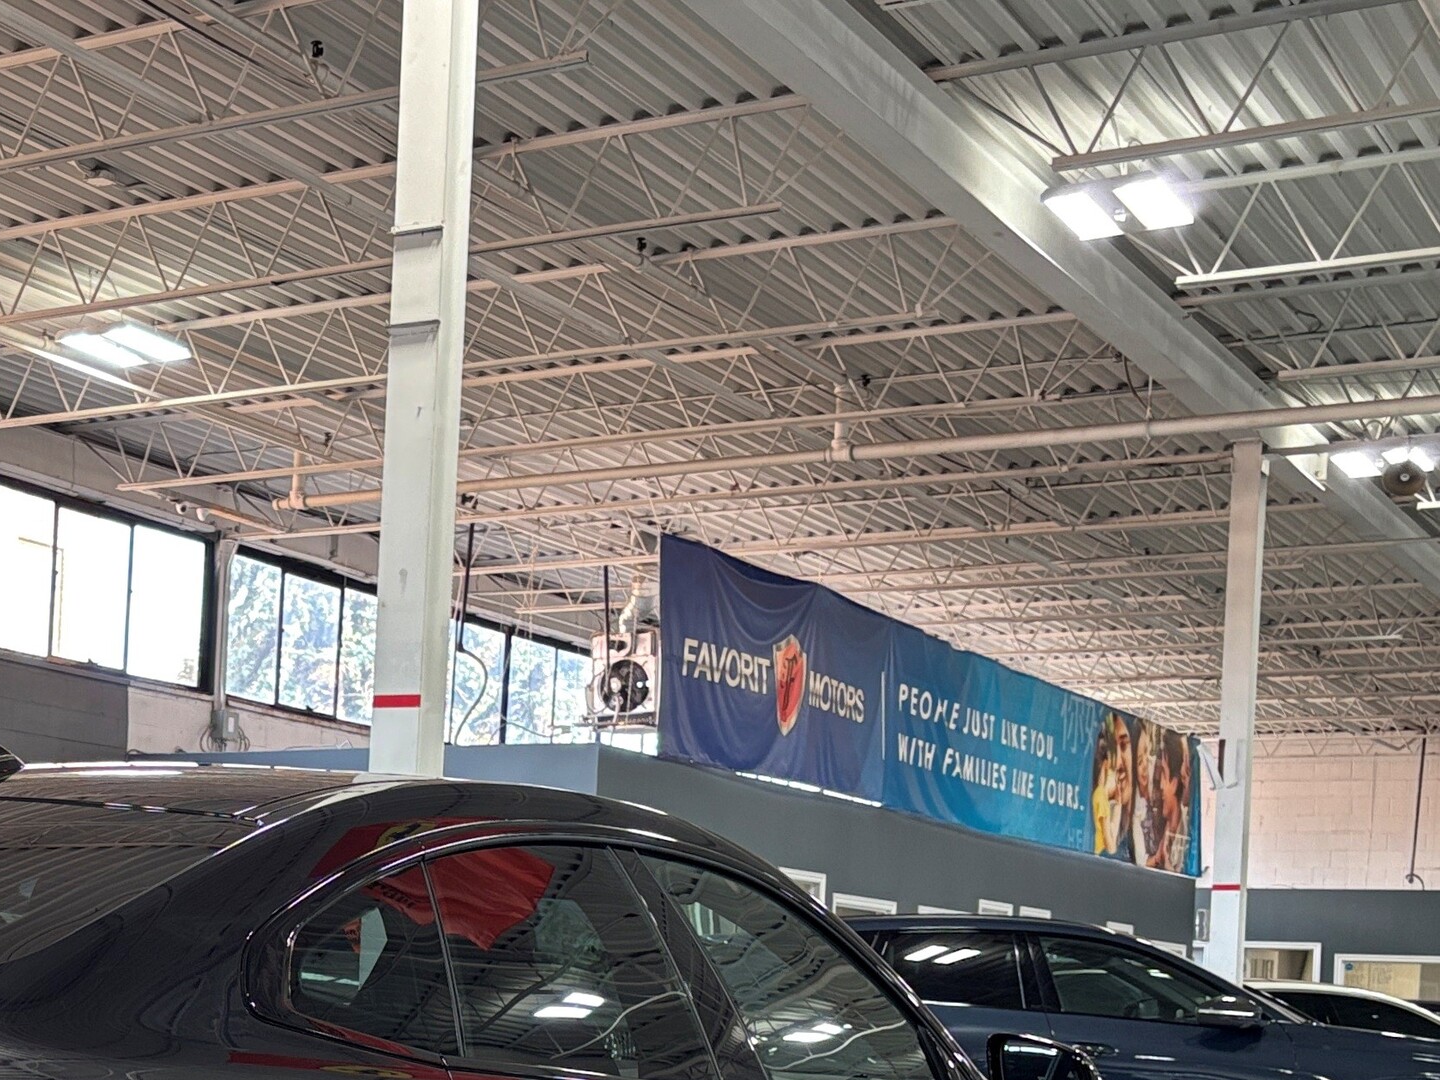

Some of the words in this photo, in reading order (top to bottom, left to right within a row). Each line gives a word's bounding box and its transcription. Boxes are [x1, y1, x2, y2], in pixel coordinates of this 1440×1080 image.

[682, 637, 771, 695] FAVORIT
[808, 670, 865, 724] MOTORS
[962, 707, 996, 741] JUST
[1001, 718, 1028, 752] LIKE
[897, 732, 937, 771] WITH
[1011, 768, 1035, 800] LIKE
[1040, 776, 1086, 812] YOURS.
